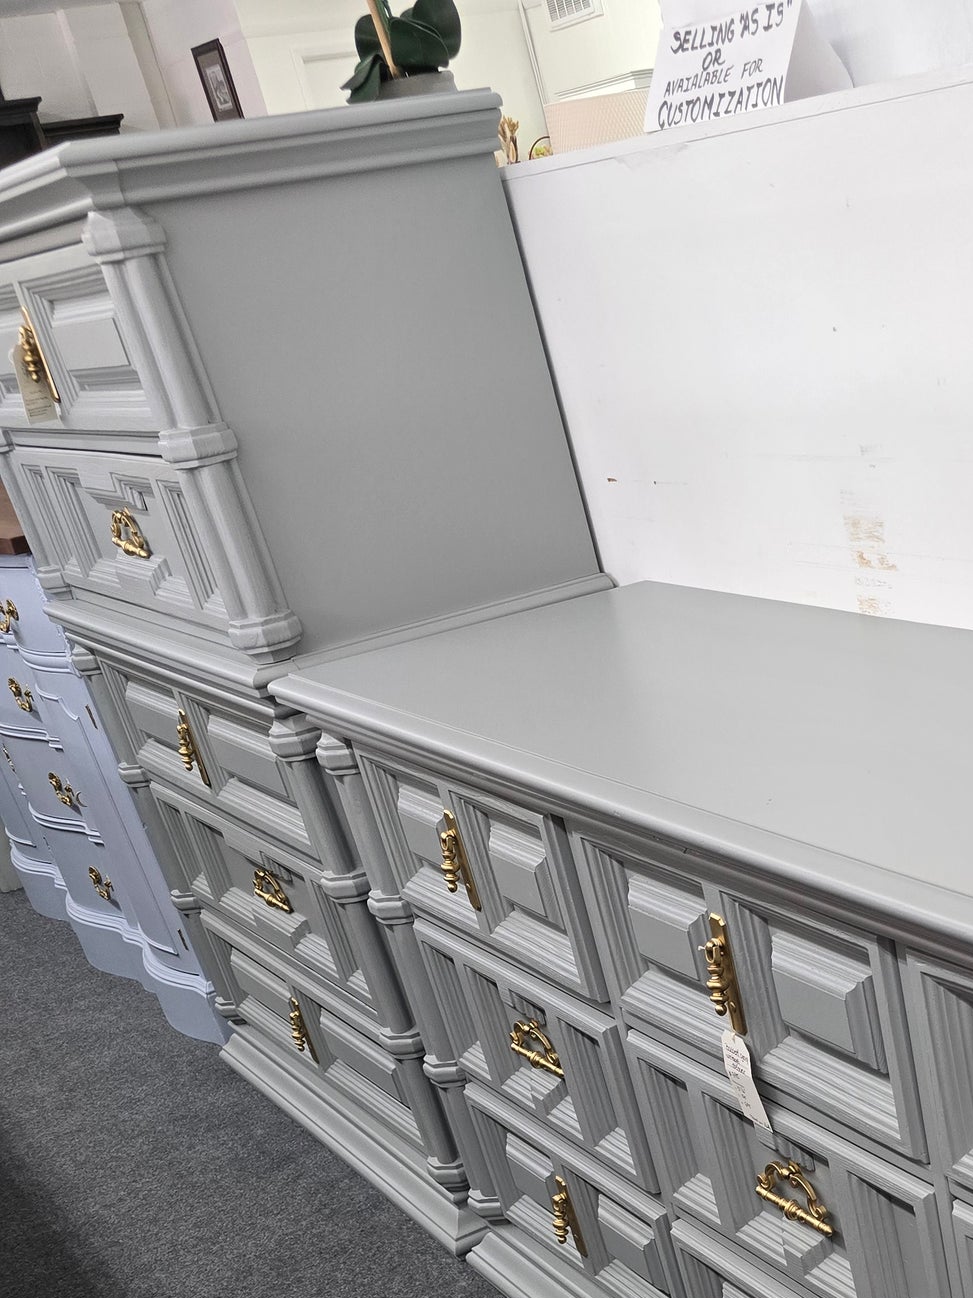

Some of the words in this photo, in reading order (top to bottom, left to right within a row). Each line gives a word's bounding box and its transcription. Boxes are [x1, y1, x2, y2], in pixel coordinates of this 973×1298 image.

[670, 17, 735, 54] SELLING
[701, 47, 726, 71] OR
[740, 57, 764, 80] FOR
[657, 75, 784, 130] CUSTOMIZATION
